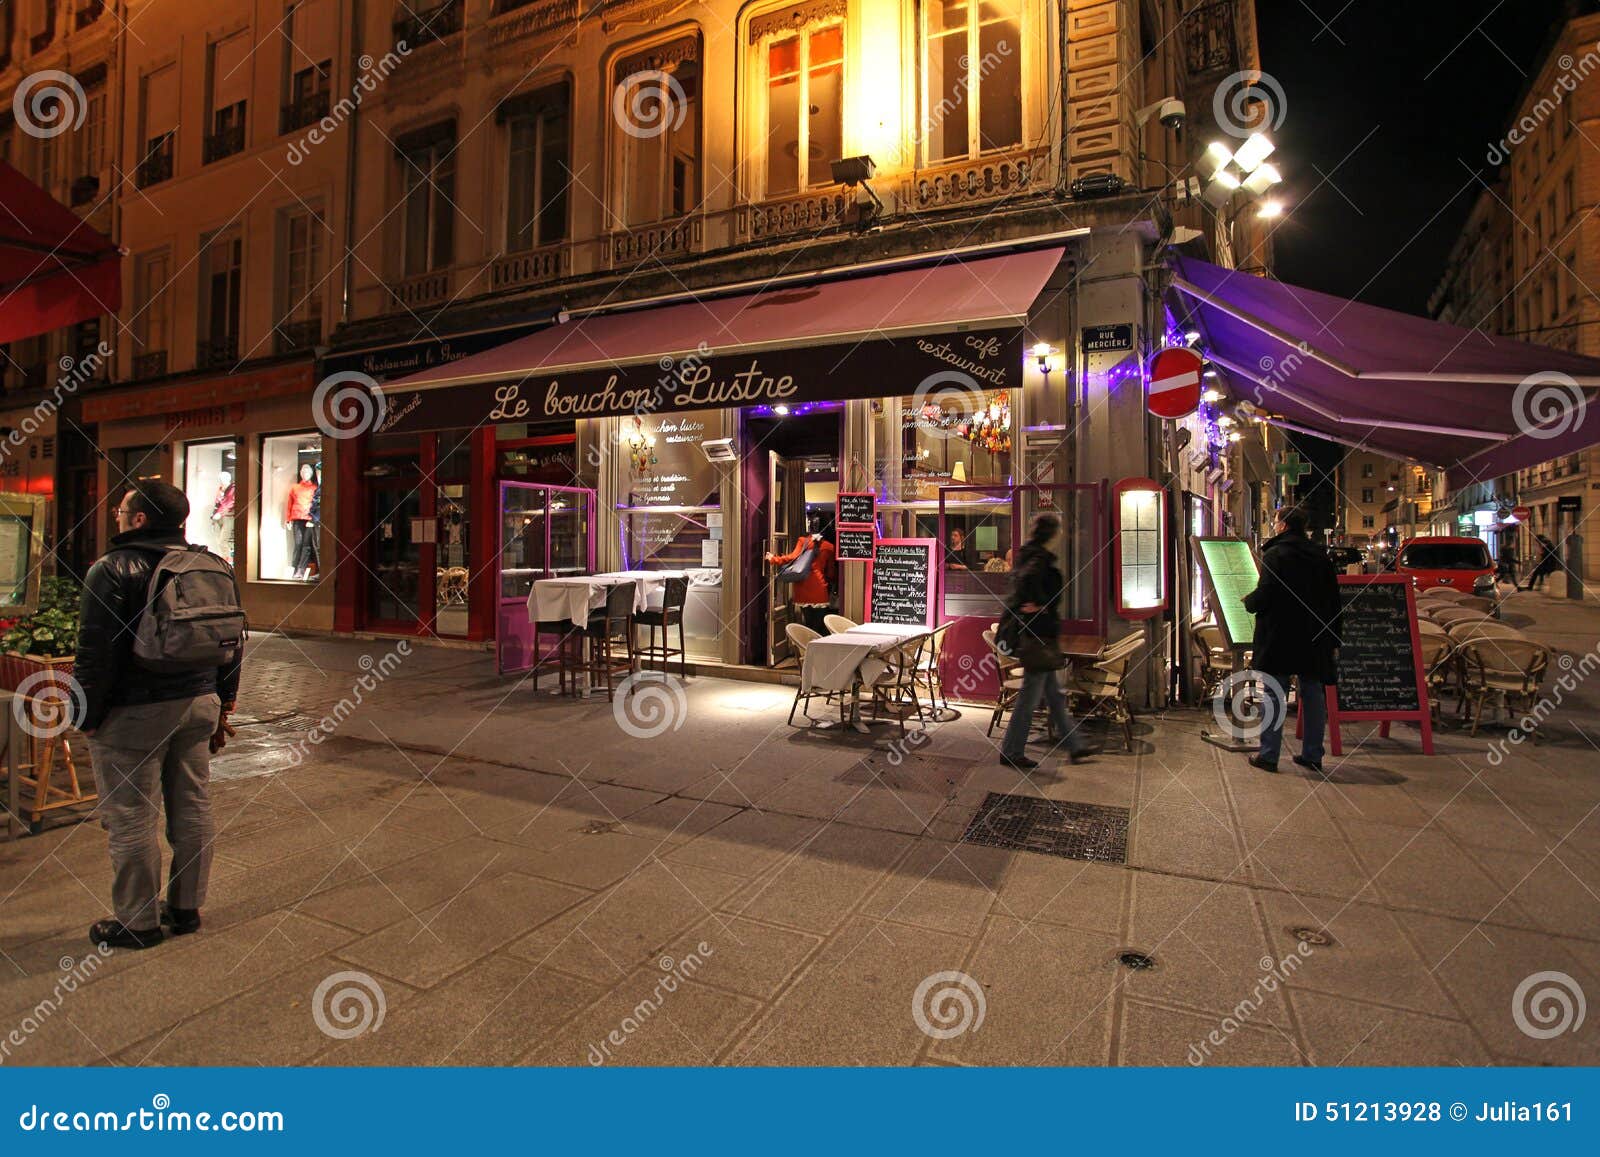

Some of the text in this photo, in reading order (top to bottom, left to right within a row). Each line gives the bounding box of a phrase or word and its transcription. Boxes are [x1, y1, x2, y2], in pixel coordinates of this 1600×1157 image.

[965, 336, 1002, 359] café
[1099, 331, 1116, 340] RUE
[917, 339, 1007, 384] restaurant
[489, 359, 799, 420] Le bouchon Lustre
